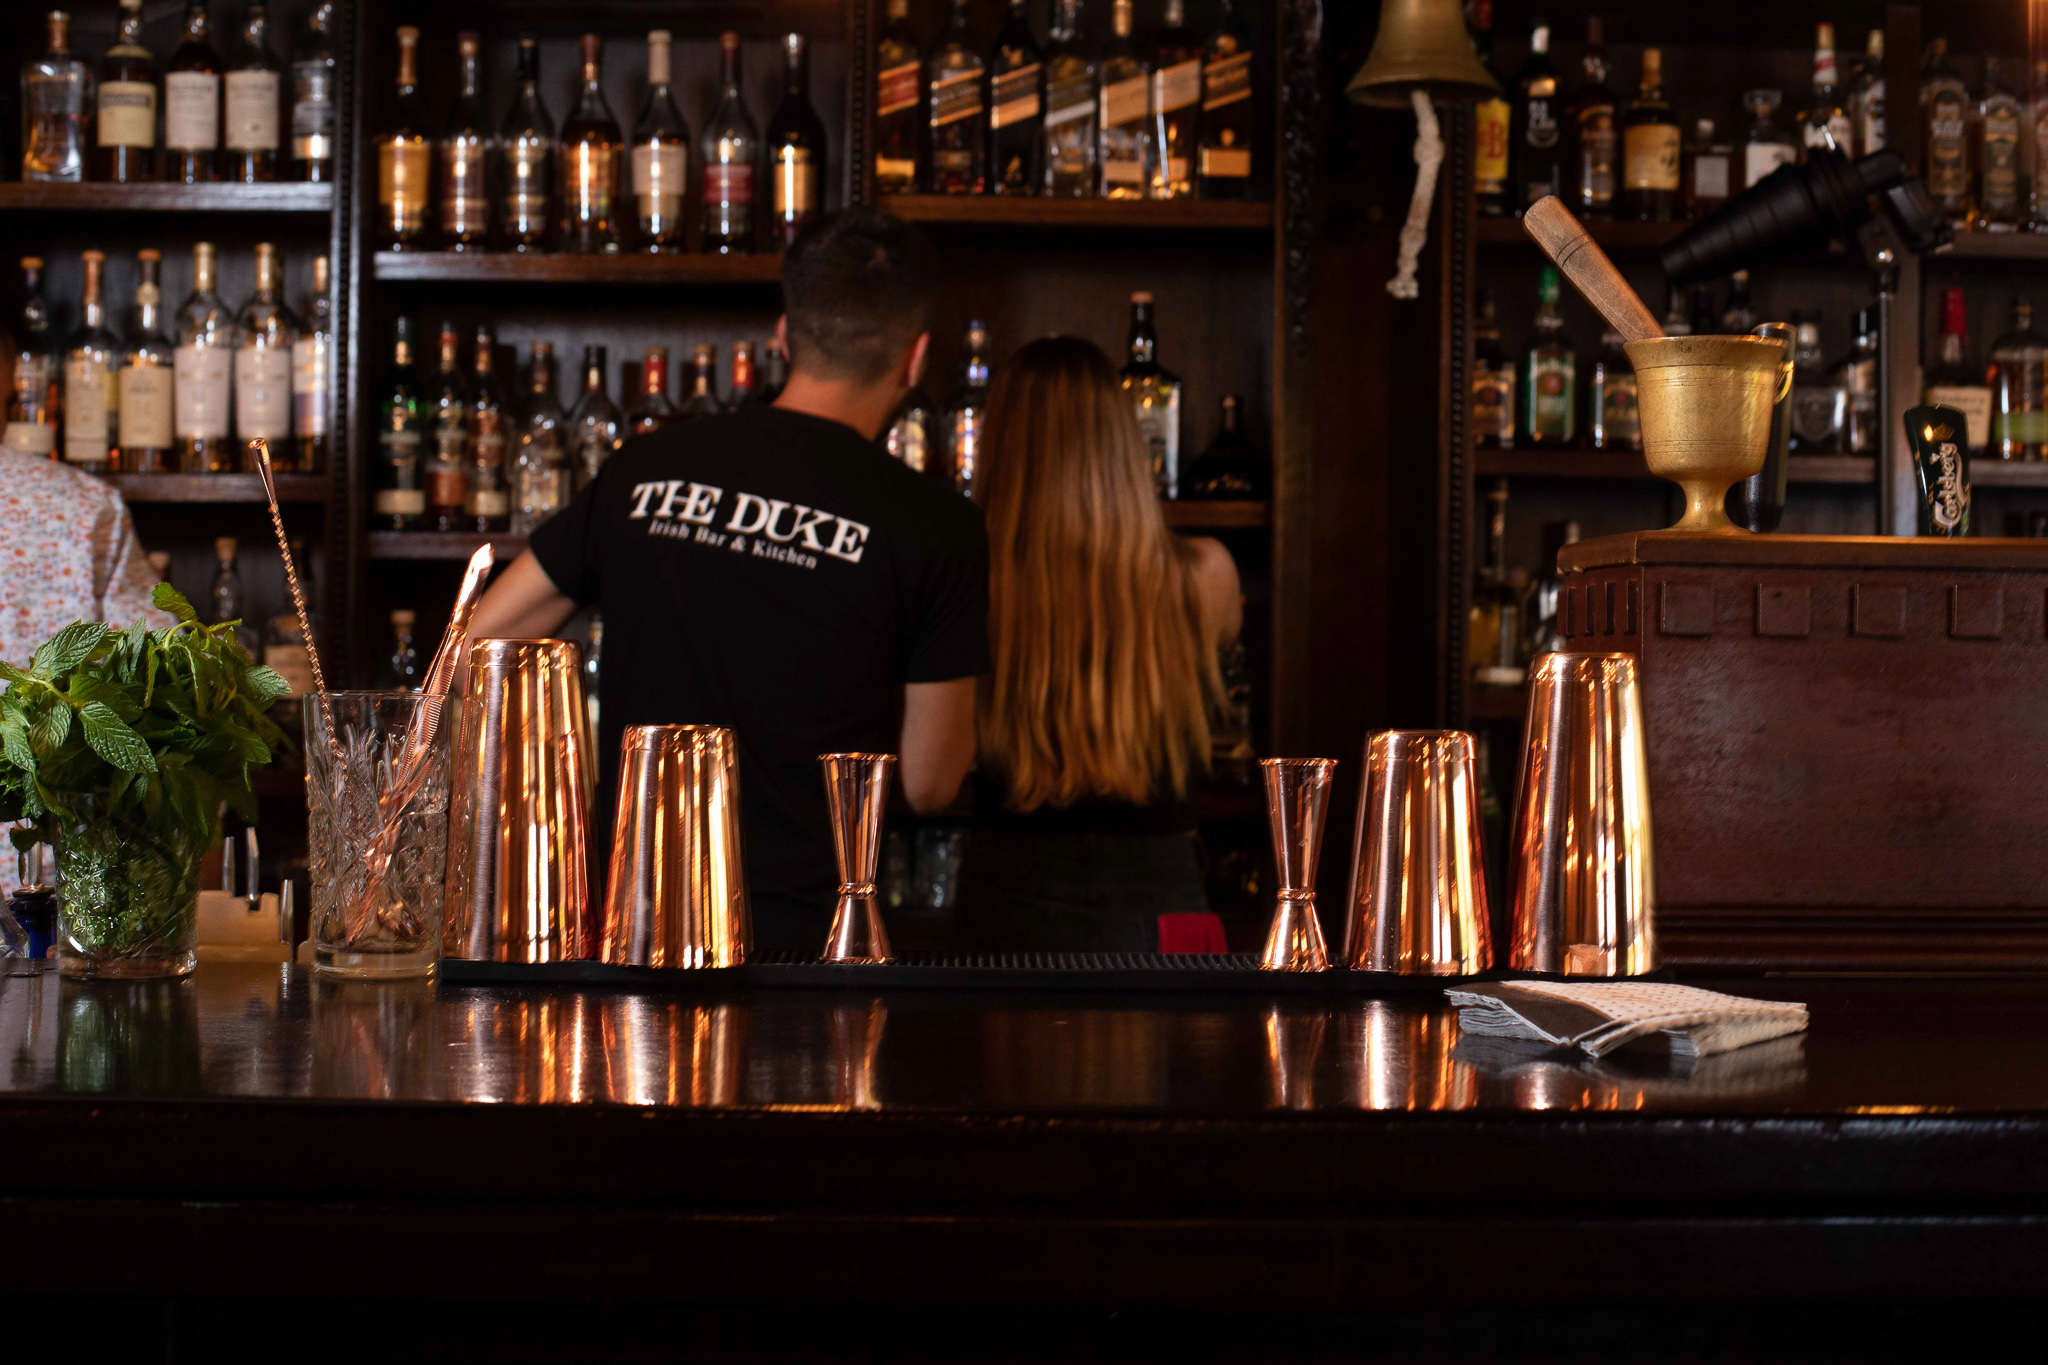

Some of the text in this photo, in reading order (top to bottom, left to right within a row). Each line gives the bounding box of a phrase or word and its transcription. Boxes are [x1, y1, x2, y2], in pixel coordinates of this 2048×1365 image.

[629, 479, 871, 564] THE DUKE
[1932, 441, 1967, 529] Carlsberg
[649, 519, 817, 569] Irish Bar & Kitchen
